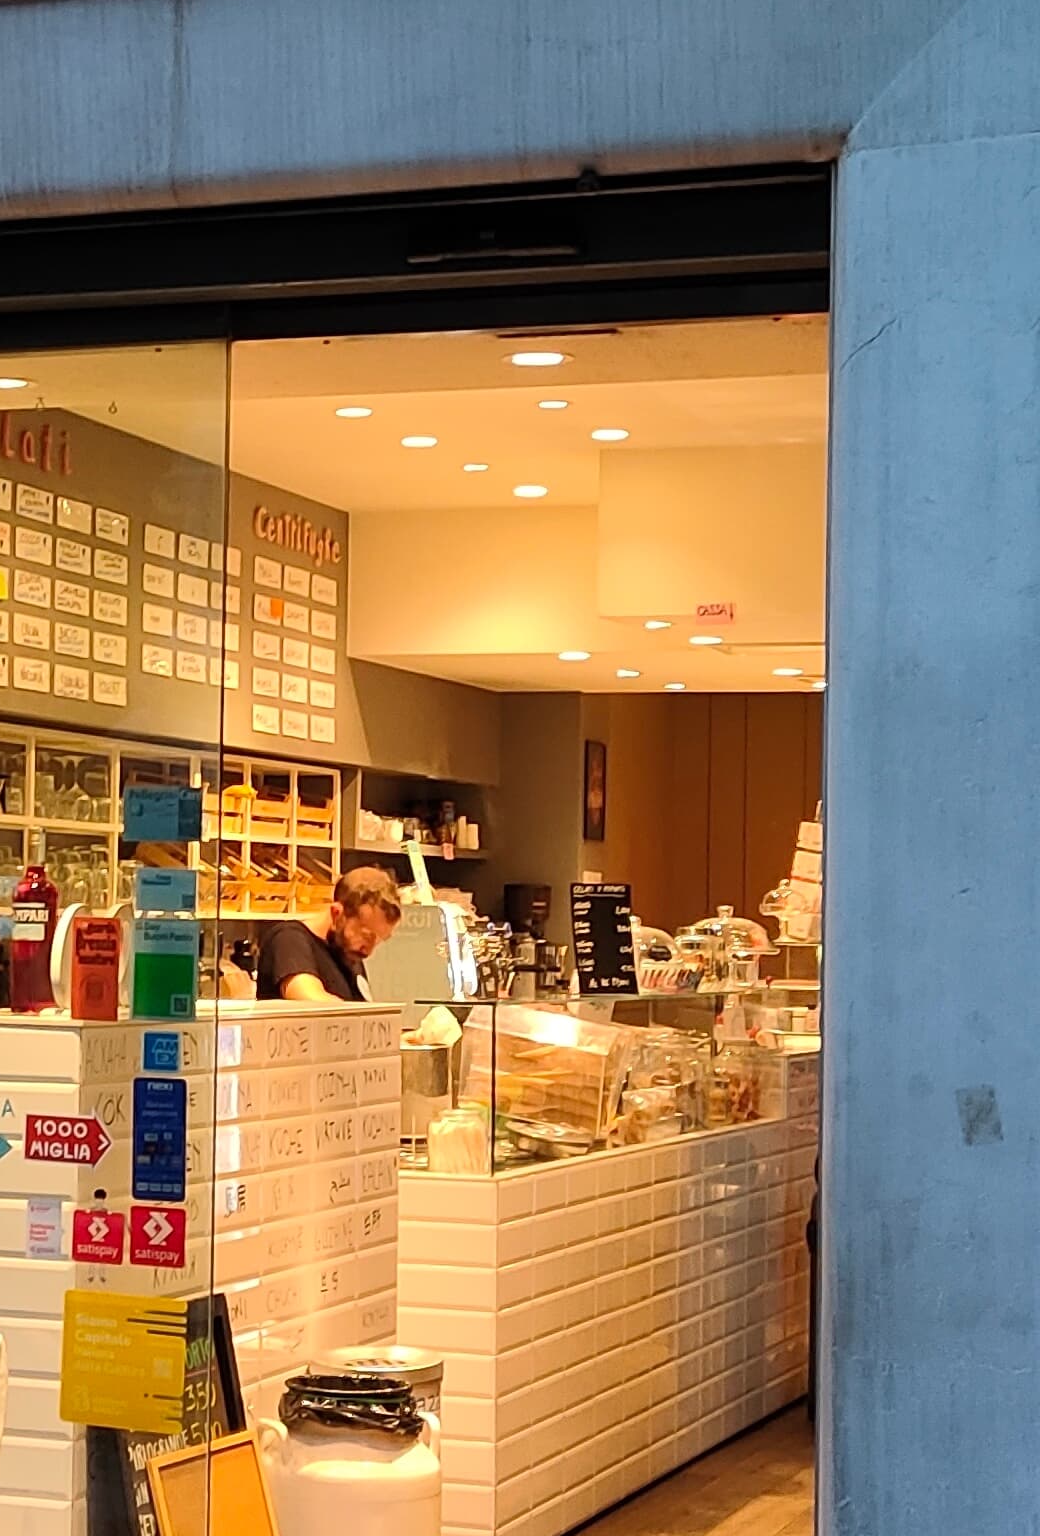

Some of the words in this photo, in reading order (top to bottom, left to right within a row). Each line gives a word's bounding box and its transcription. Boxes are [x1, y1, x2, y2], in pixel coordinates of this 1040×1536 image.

[33, 1119, 89, 1139] 1000
[29, 1140, 91, 1161] MIGLIA
[77, 1244, 119, 1257] satispay
[134, 1249, 181, 1265] satispay
